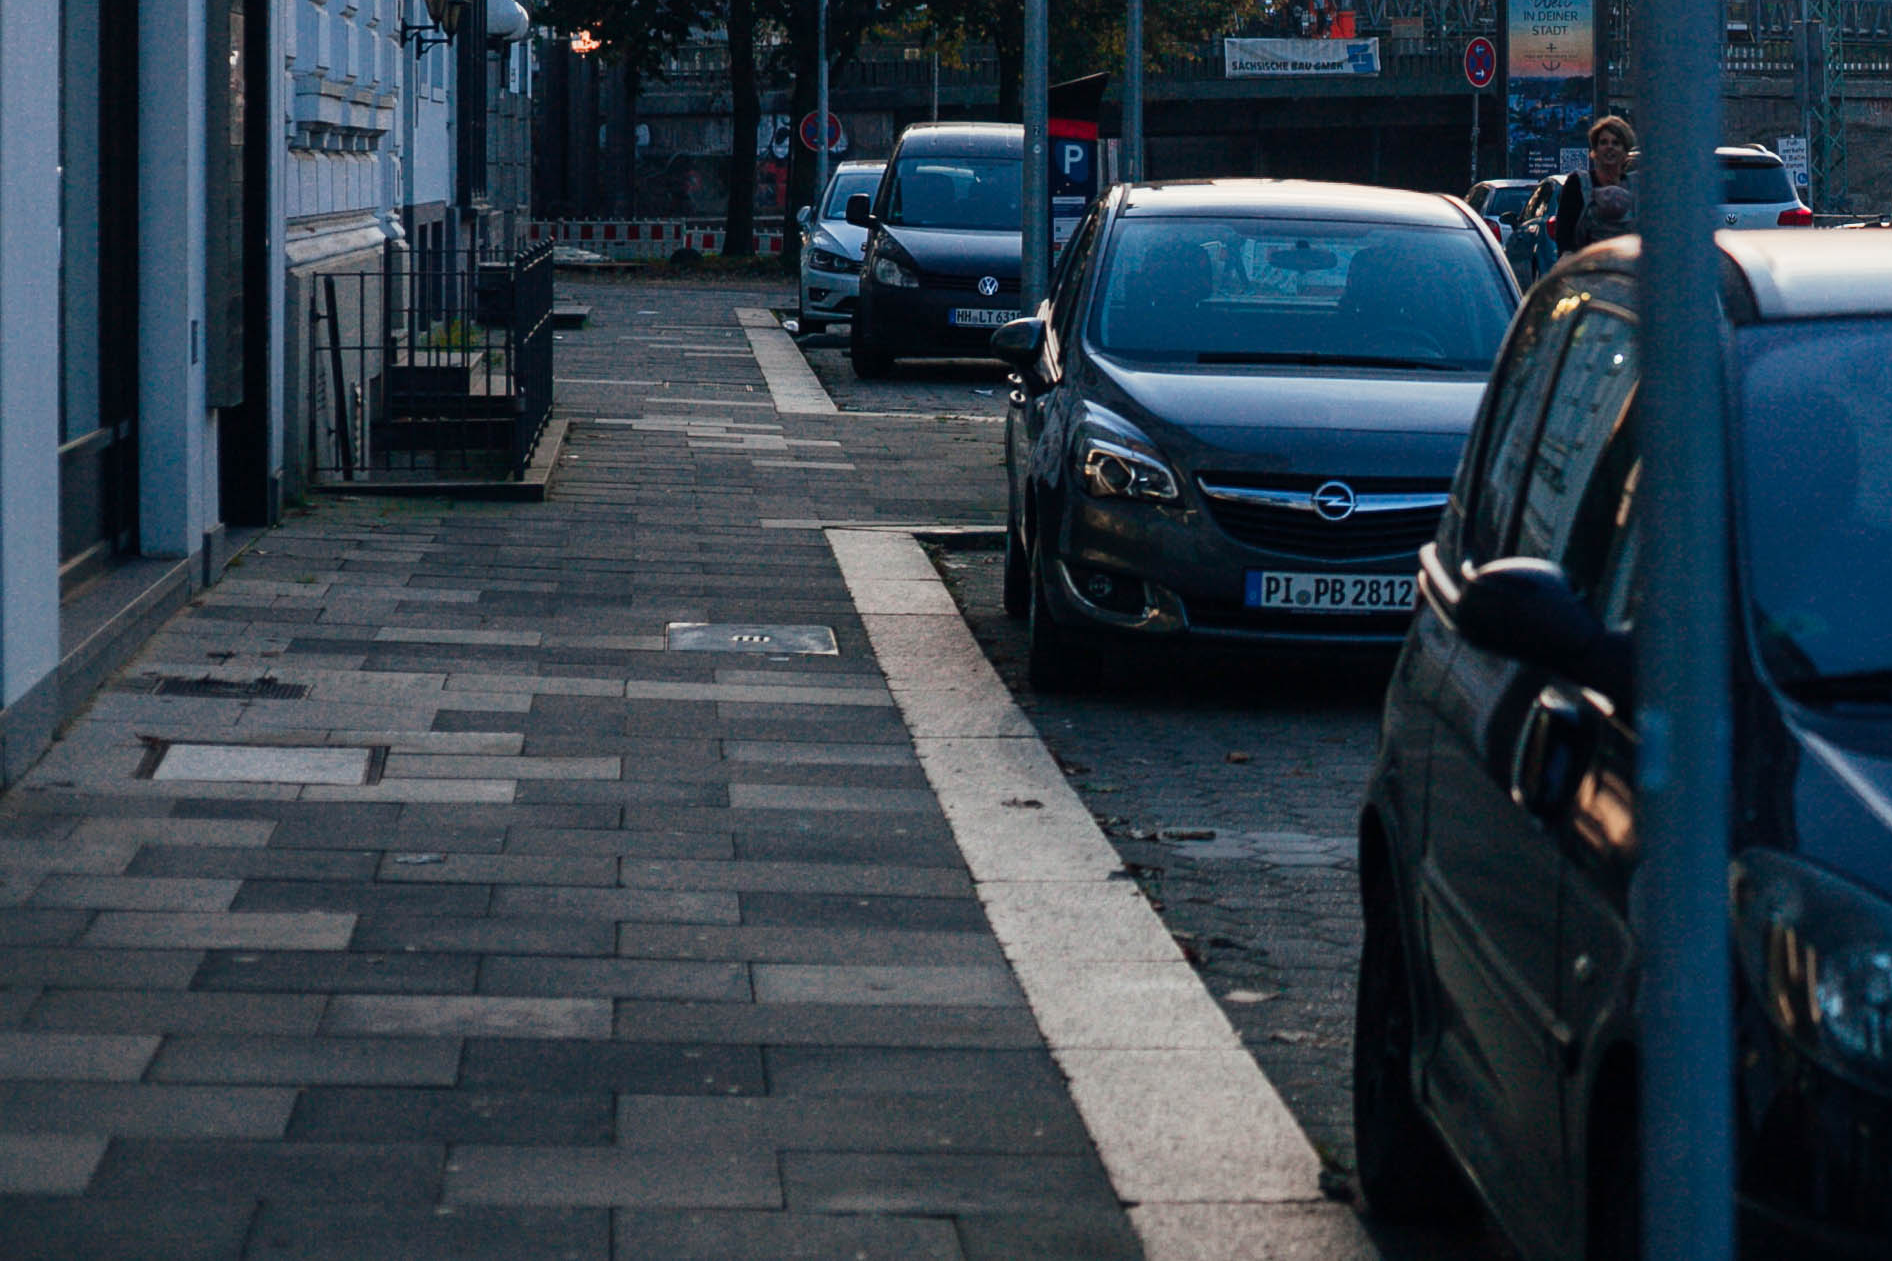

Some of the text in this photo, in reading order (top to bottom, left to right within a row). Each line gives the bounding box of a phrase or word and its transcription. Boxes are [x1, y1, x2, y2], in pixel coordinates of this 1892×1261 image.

[1524, 11, 1578, 21] IN DEINER
[1532, 25, 1568, 35] STADT
[1064, 145, 1083, 175] P
[957, 311, 971, 322] HH
[979, 312, 993, 323] LT
[1265, 576, 1413, 606] PI PB 2812
